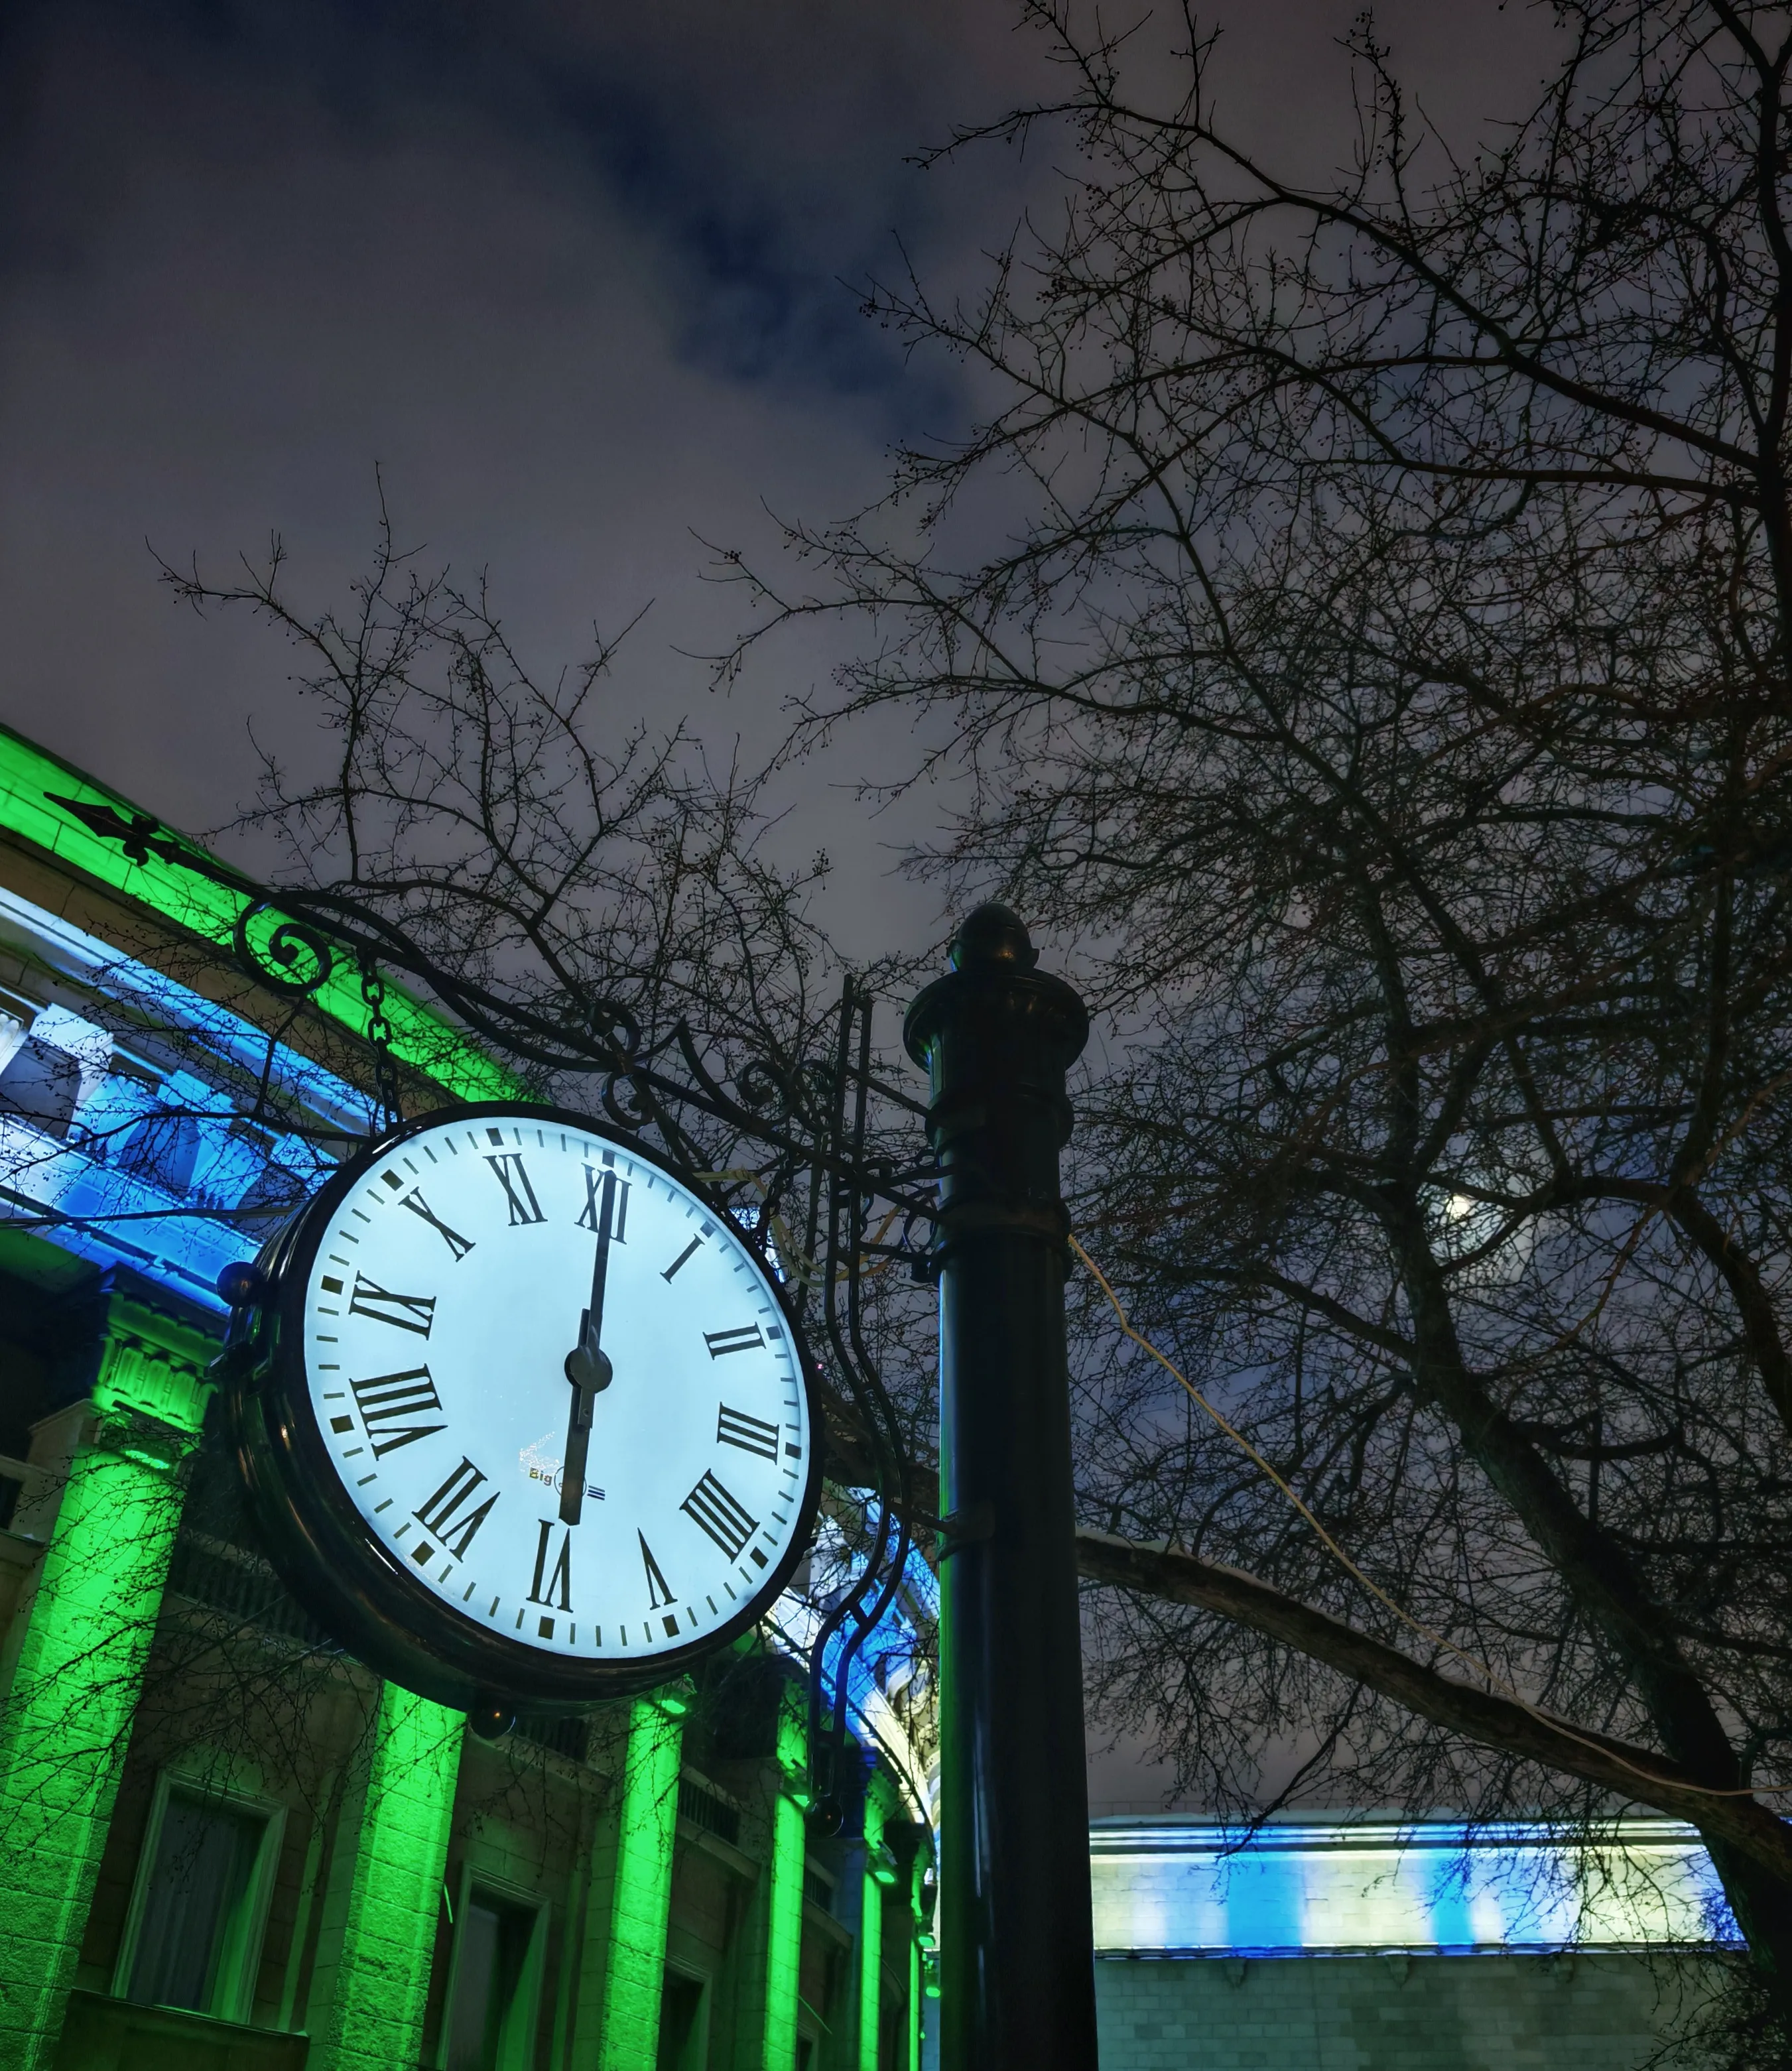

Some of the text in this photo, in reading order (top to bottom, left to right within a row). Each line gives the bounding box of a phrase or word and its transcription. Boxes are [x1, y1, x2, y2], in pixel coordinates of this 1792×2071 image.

[398, 1186, 476, 1263] X
[482, 1153, 548, 1227] XI
[574, 1162, 633, 1245] XI
[659, 1233, 705, 1285] I
[348, 1270, 437, 1341] IX
[702, 1322, 767, 1361] II
[348, 1363, 448, 1462] VIII
[716, 1401, 780, 1466] III
[411, 1455, 501, 1564] VII
[678, 1468, 761, 1565] IIII
[525, 1519, 574, 1613] VI
[637, 1527, 678, 1611] V
